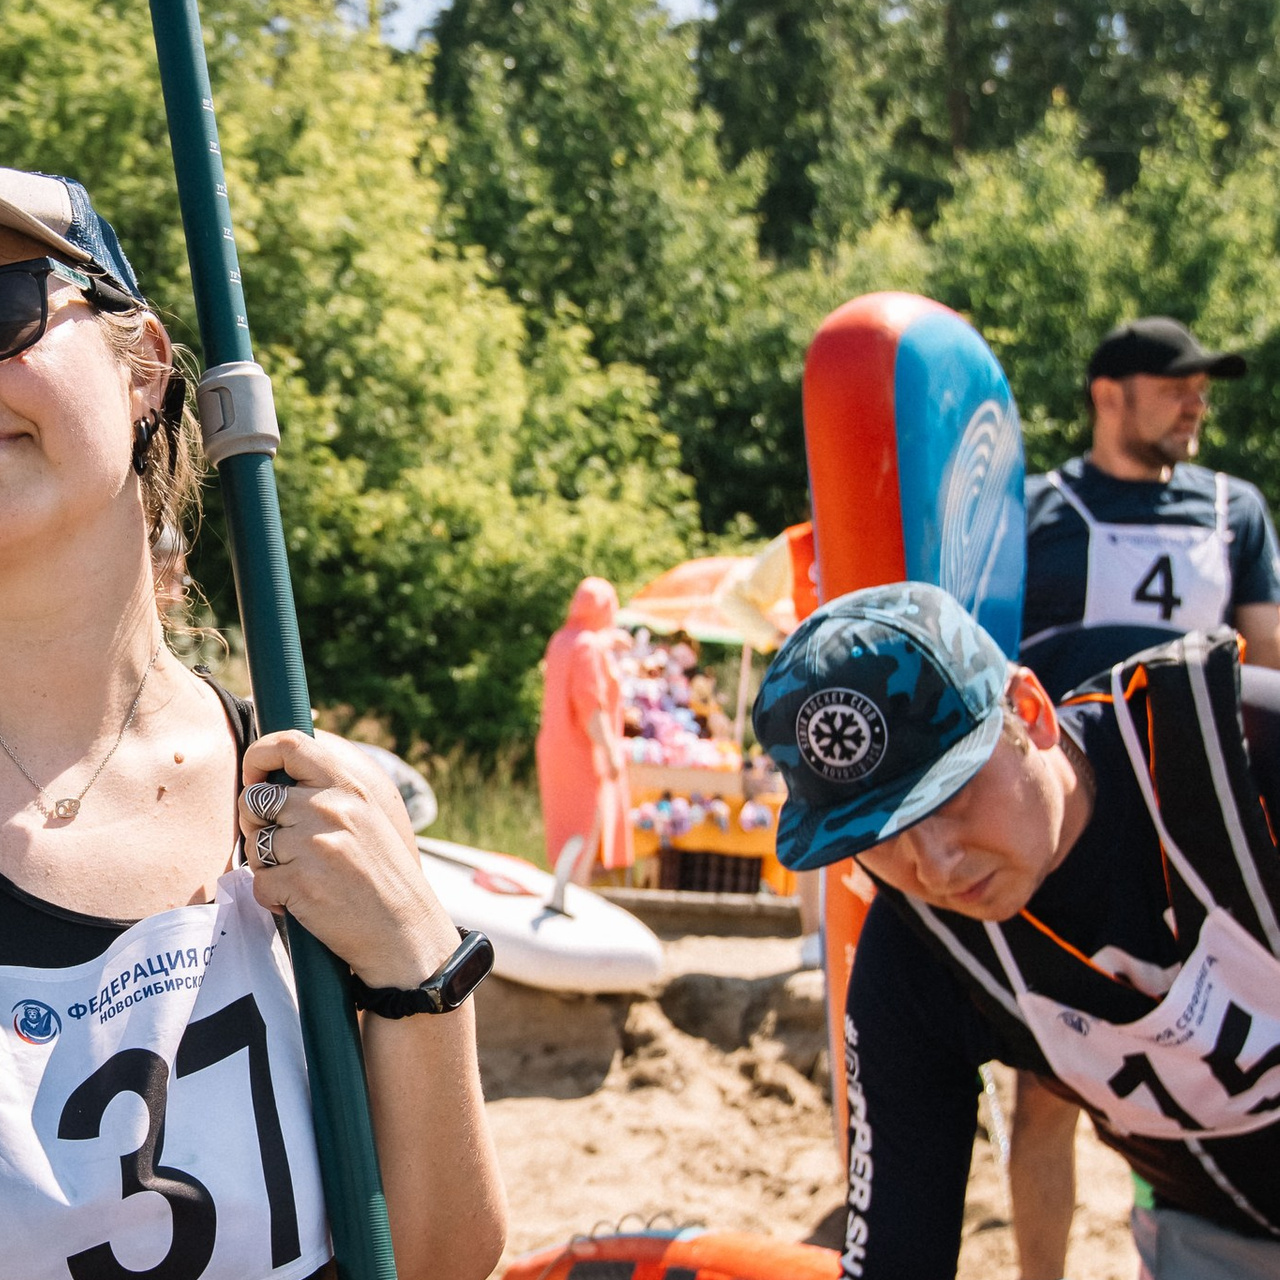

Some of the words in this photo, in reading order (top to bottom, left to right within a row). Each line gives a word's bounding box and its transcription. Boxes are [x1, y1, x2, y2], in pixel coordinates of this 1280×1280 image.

[1133, 554, 1181, 621] 4
[804, 692, 846, 716] HOCKEY
[850, 696, 877, 721] CLUB
[67, 947, 199, 1020] ФЕДЕРАЦИЯ
[99, 972, 206, 1024] НОВОСИБИРСКО
